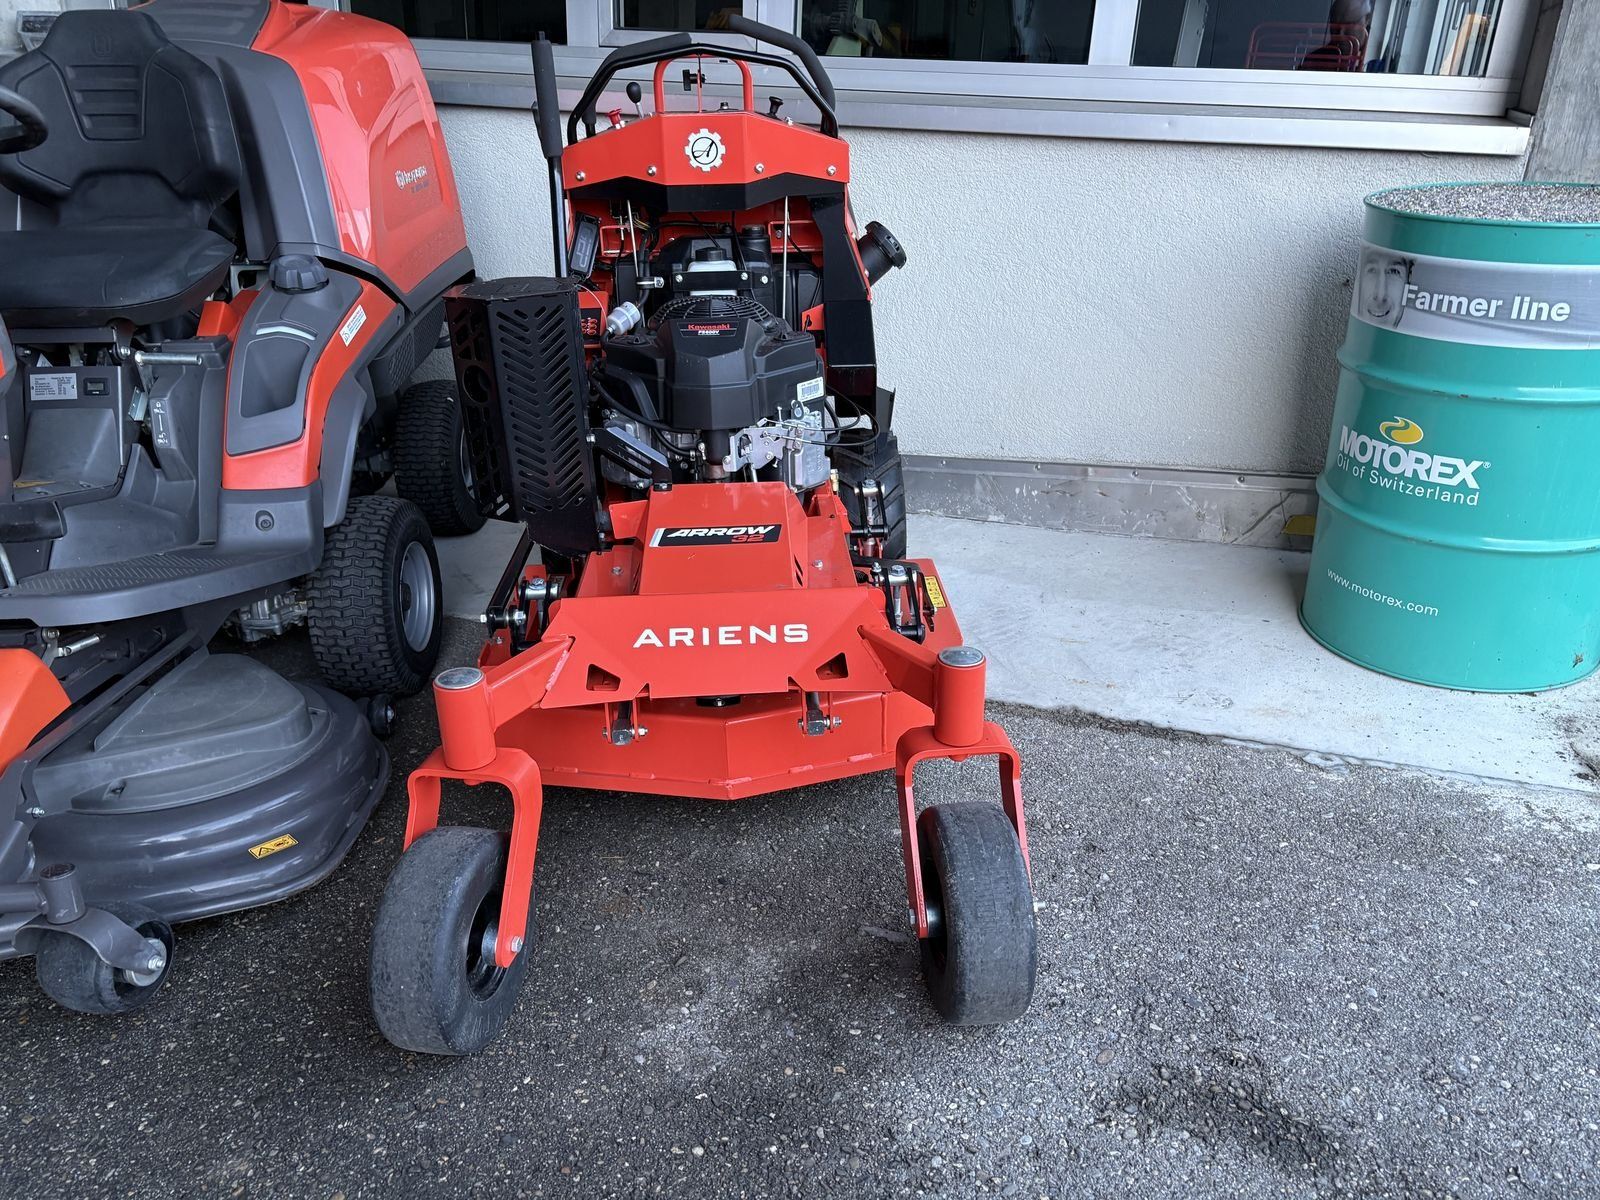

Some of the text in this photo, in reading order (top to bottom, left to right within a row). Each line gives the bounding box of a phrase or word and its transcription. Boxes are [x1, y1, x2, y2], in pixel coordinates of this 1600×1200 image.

[1402, 284, 1571, 322] Farmer line
[688, 323, 730, 331] Kawasaki
[1337, 454, 1480, 506] Oil of Switzerland
[666, 525, 776, 538] ARROW
[731, 534, 765, 543] 32
[1327, 568, 1439, 617] www.motorex.com
[632, 623, 809, 649] ARIENS
